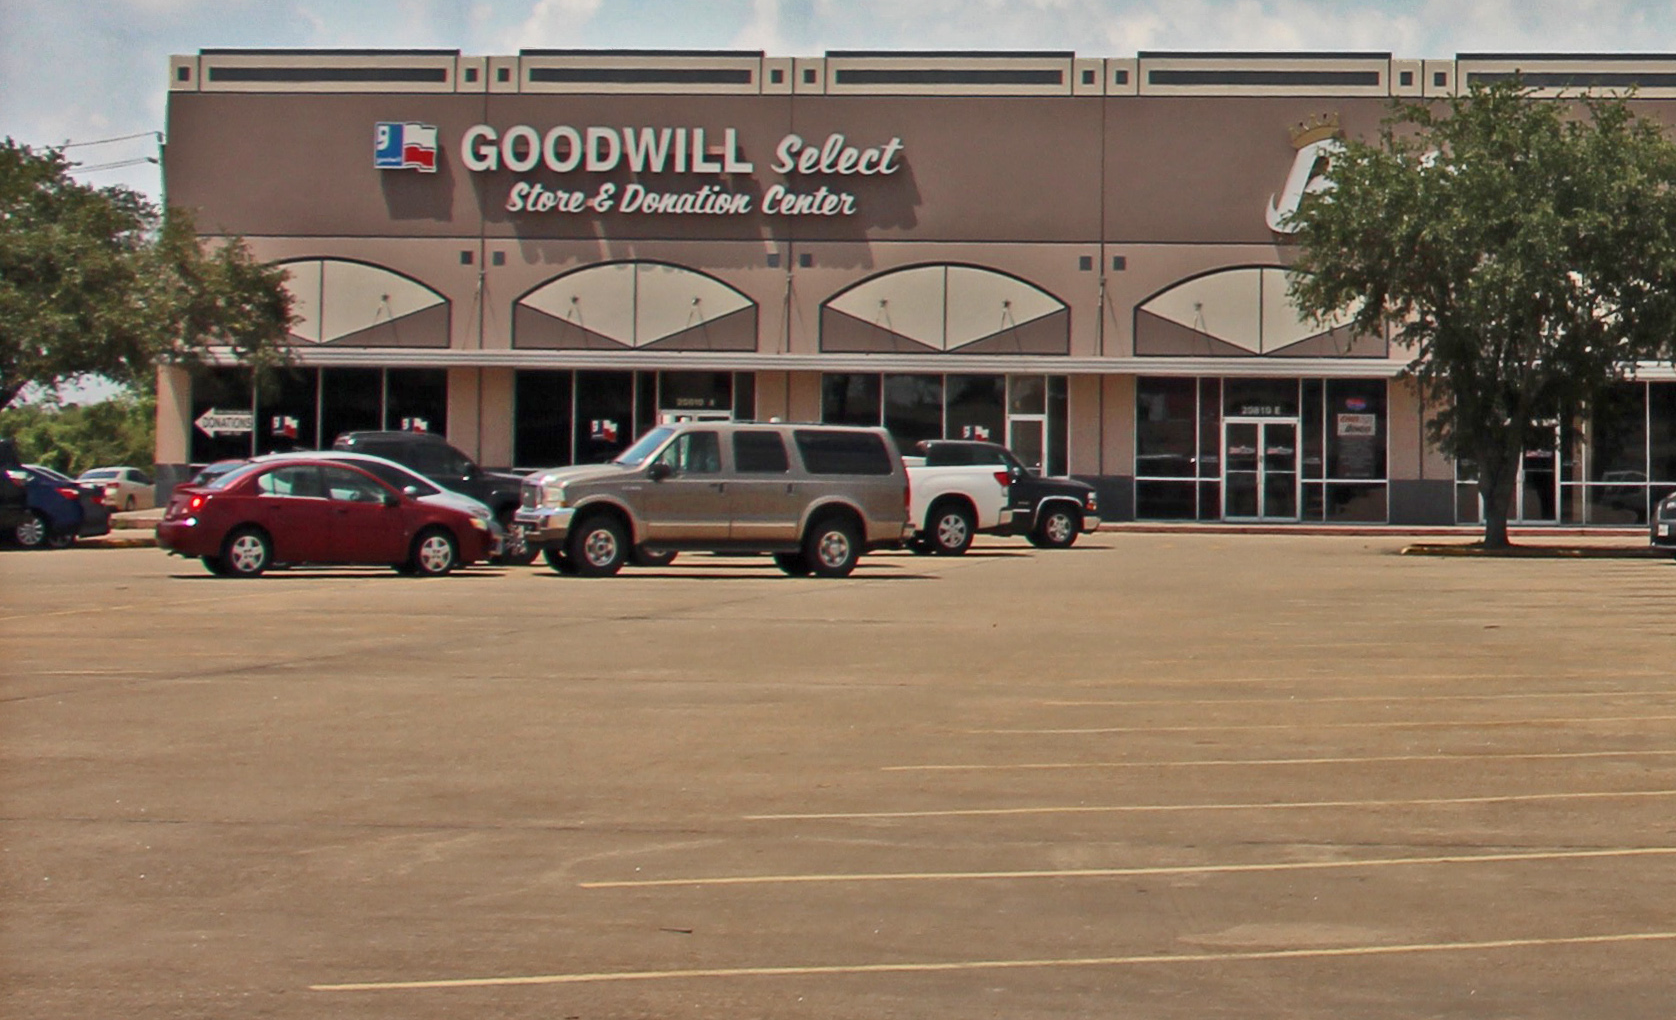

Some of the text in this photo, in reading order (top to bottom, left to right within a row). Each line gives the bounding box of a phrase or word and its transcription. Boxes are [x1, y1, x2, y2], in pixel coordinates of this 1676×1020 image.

[461, 125, 903, 176] GOODWILL Select
[506, 181, 856, 216] Store & Donation Center
[201, 416, 253, 430] DONATIONS
